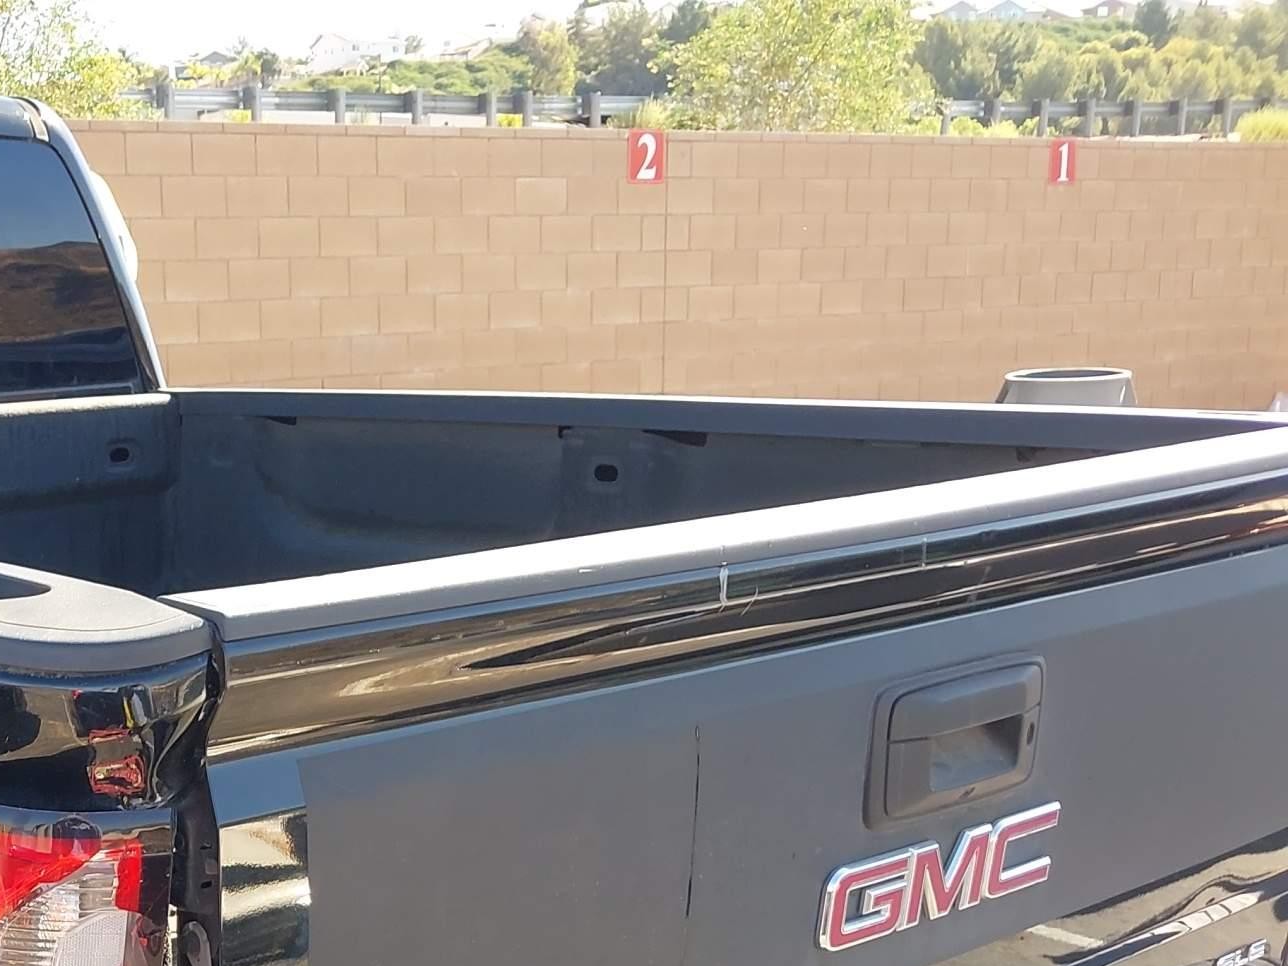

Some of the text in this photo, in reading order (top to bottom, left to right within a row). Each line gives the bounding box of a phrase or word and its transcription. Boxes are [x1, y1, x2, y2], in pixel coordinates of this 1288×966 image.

[636, 132, 657, 180] 2
[1057, 142, 1069, 182] 1
[817, 801, 1062, 952] GMC
